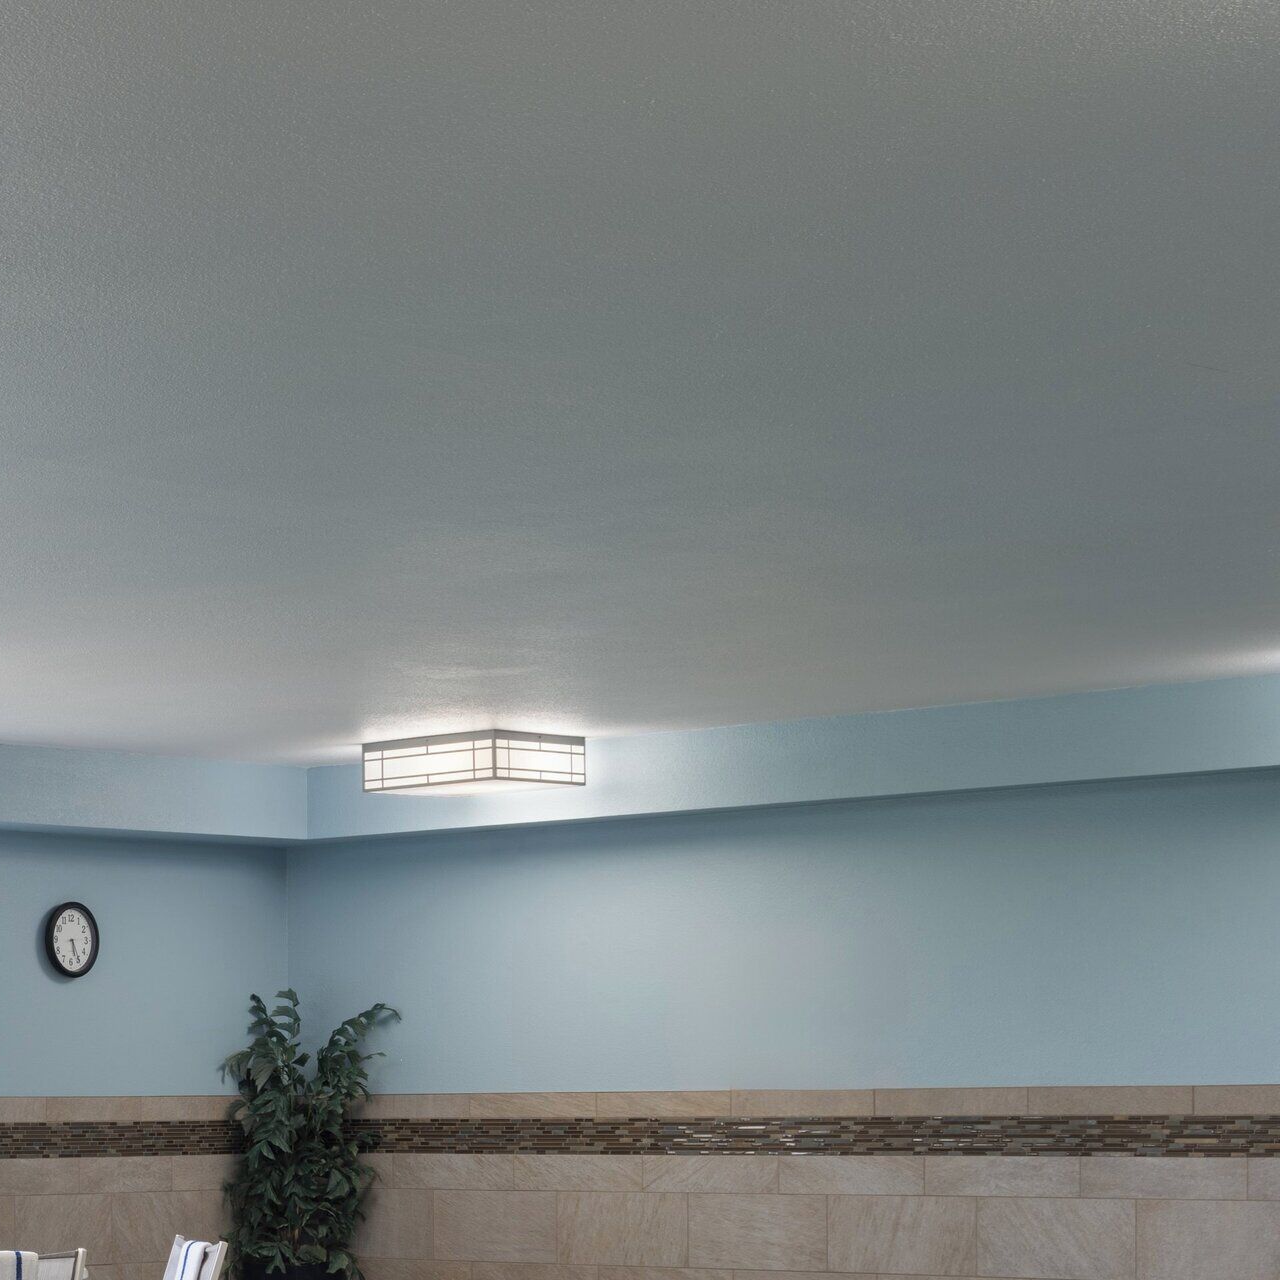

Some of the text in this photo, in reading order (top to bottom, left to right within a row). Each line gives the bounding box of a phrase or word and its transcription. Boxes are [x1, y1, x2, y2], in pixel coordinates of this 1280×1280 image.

[68, 914, 75, 922] 12
[81, 925, 86, 934] 2
[53, 935, 58, 944] 9
[83, 936, 88, 945] 3
[56, 946, 60, 955] 8
[82, 947, 86, 956] 4
[61, 954, 66, 963] 7
[68, 957, 73, 966] 6
[76, 955, 81, 964] 5
